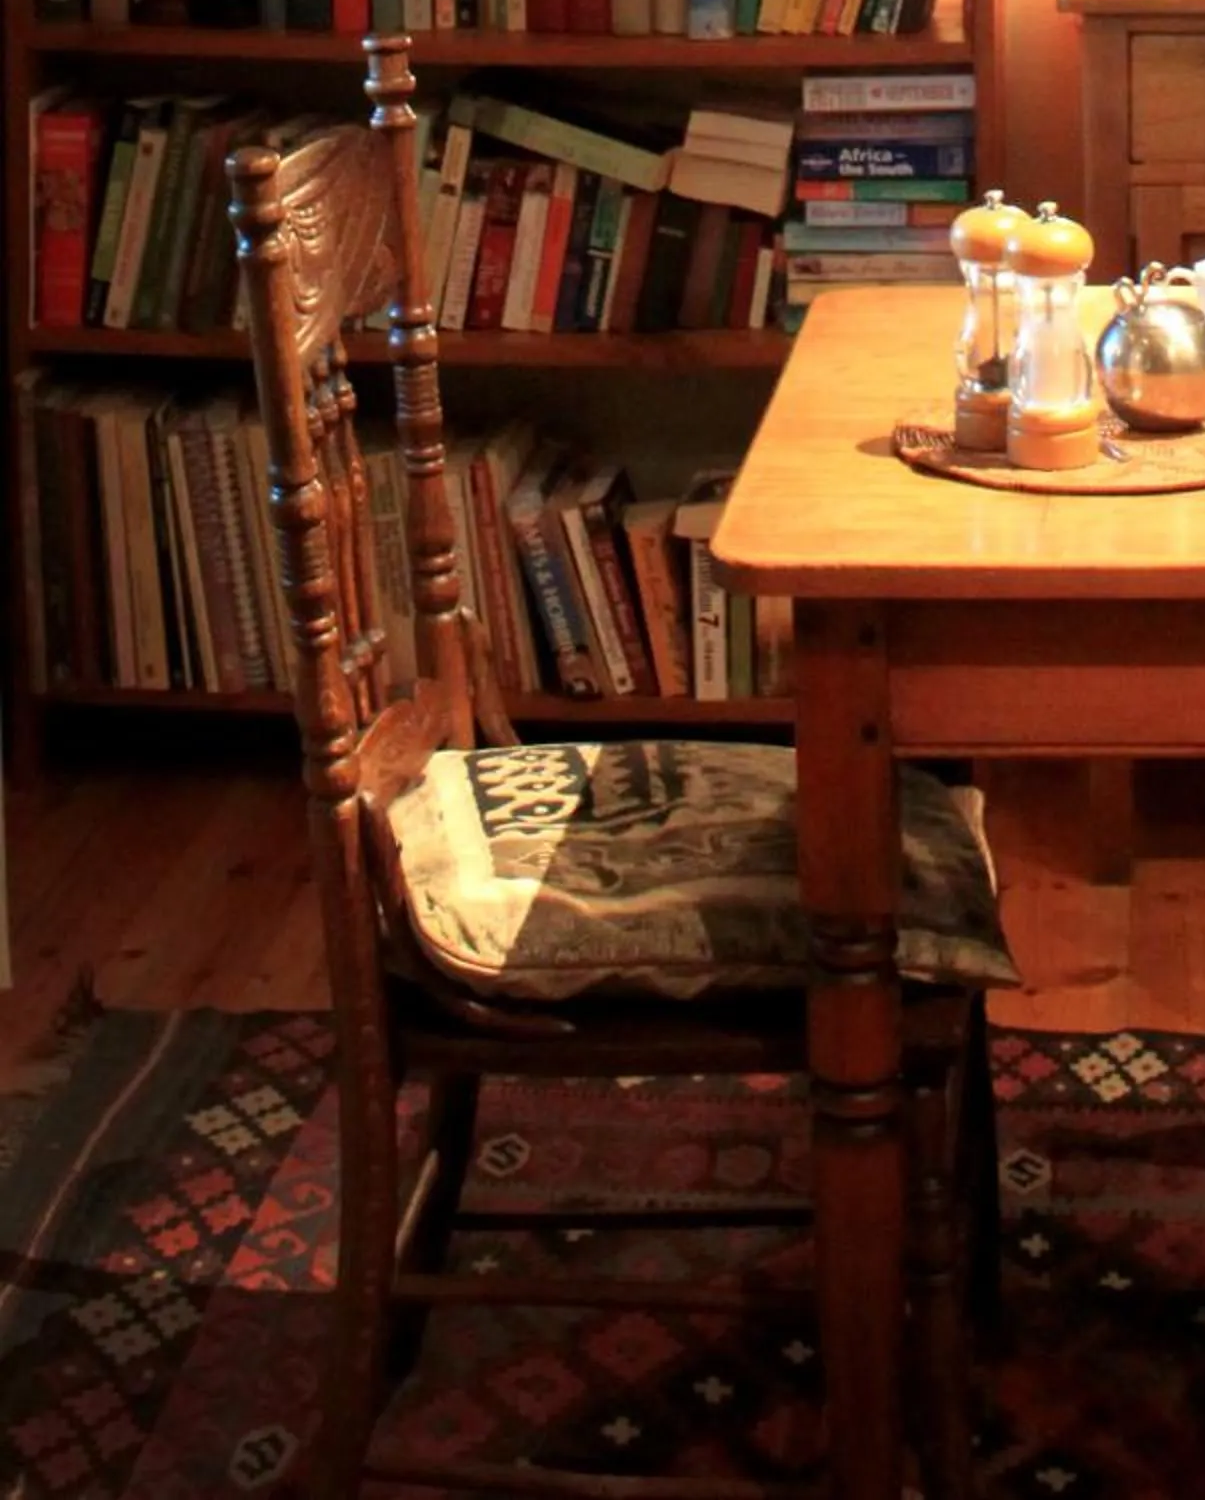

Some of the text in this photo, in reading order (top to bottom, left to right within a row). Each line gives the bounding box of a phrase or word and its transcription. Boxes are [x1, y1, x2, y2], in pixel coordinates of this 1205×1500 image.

[839, 148, 893, 162] Africa
[839, 163, 914, 176] the South
[699, 615, 719, 628] 7
